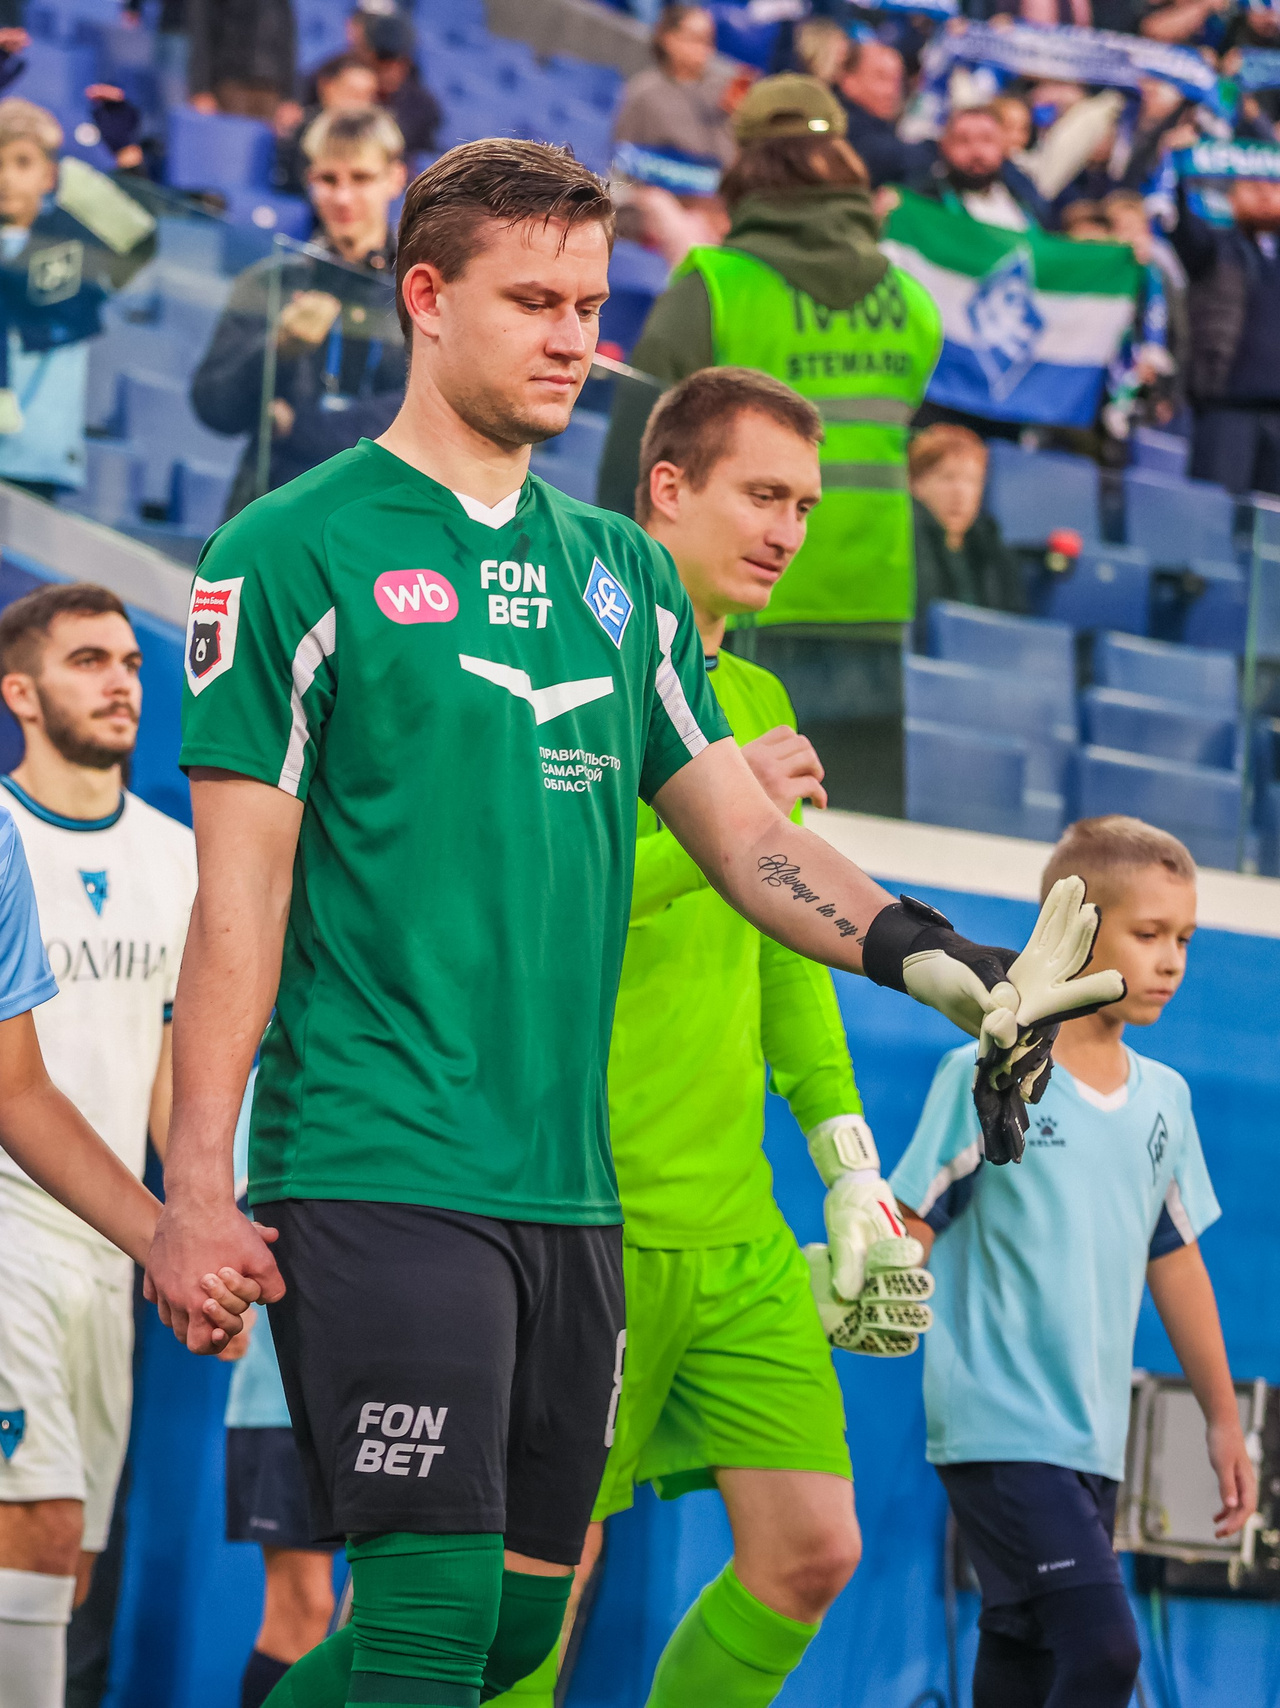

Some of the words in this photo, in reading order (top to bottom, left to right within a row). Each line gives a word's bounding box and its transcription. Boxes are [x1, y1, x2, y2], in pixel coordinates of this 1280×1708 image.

[381, 573, 450, 613] wb
[480, 559, 547, 594] FON
[488, 594, 553, 629] BET
[757, 854, 820, 903] Always
[816, 903, 836, 918] in
[834, 918, 858, 938] my
[357, 1401, 449, 1440] FON
[354, 1439, 446, 1478] BET
